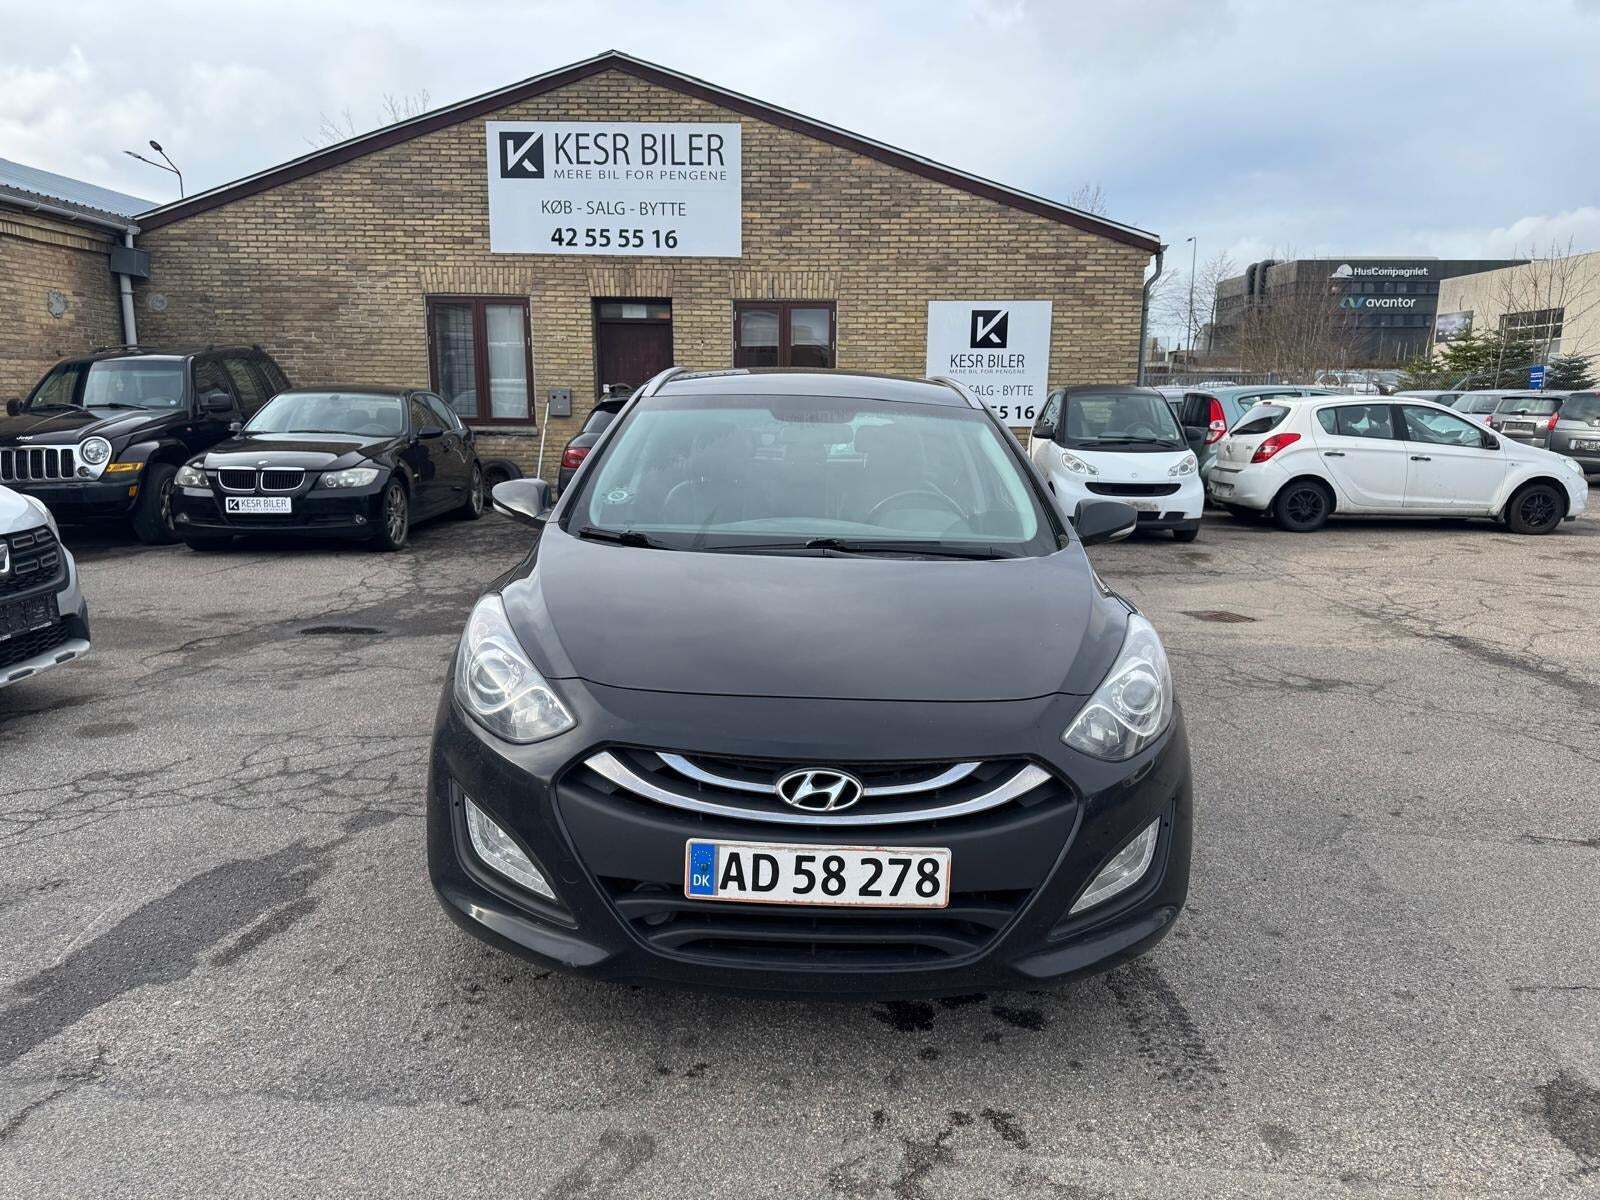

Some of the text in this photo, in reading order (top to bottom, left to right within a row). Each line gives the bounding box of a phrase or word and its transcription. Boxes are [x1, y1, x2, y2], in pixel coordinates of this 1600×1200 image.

[554, 132, 725, 166] KESR BILER
[553, 169, 727, 181] MERE BIL FOR PENGENE
[541, 199, 573, 215] KØB
[586, 200, 626, 216] SALG
[640, 201, 687, 217] BYTTE
[550, 227, 678, 249] 42 55 55 16
[1354, 267, 1429, 278] HusCompagniet
[1366, 297, 1416, 308] avantor
[950, 354, 1025, 368] KESR BILER
[1002, 385, 1034, 396] BYTTE
[990, 405, 1035, 420] 5 16
[241, 499, 287, 508] KESR BILER
[693, 874, 711, 887] DK
[719, 852, 941, 898] AD 58 278
